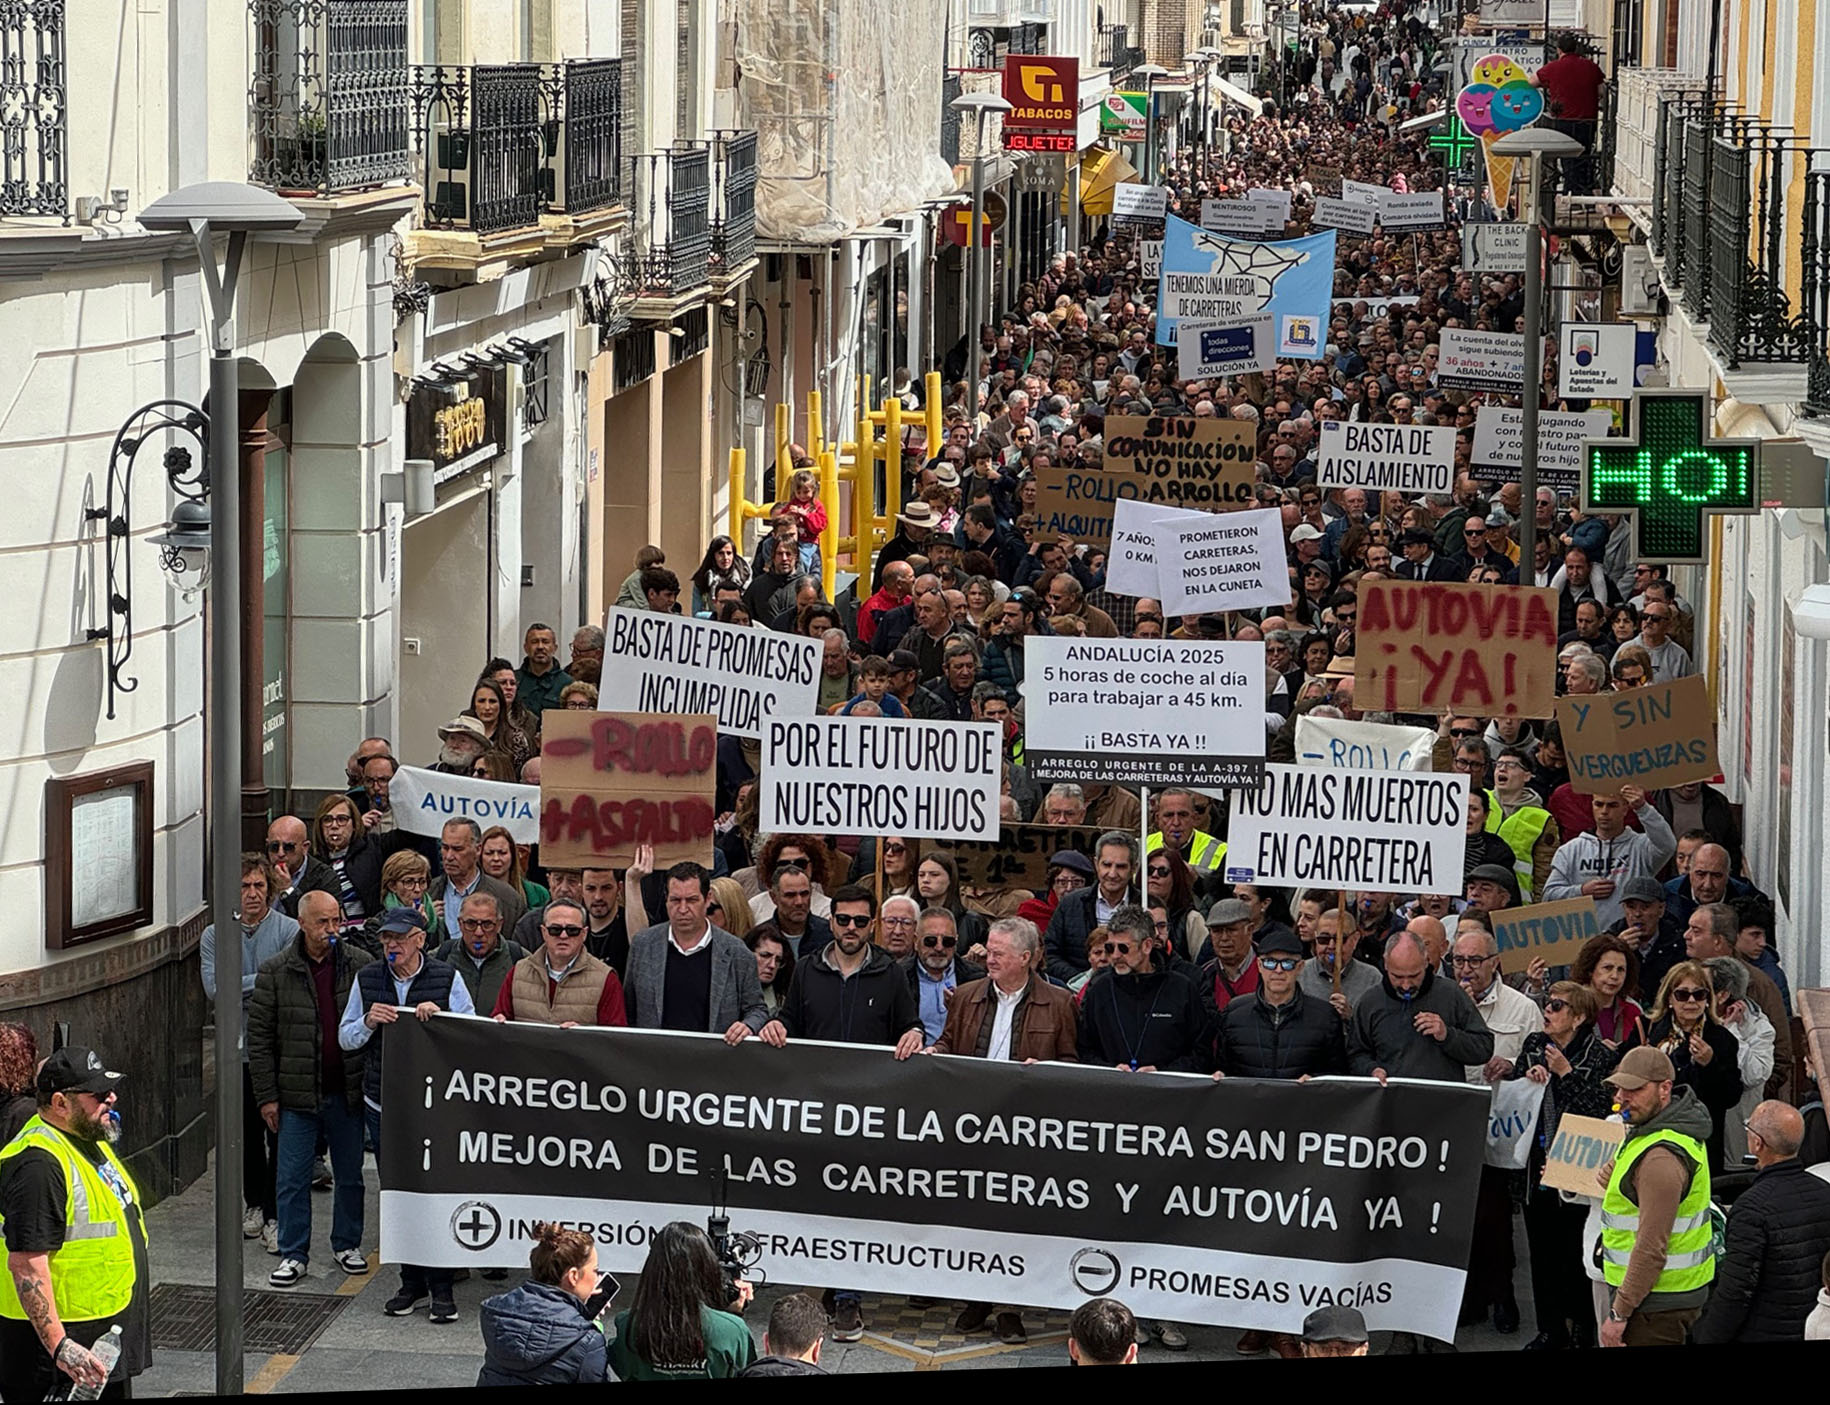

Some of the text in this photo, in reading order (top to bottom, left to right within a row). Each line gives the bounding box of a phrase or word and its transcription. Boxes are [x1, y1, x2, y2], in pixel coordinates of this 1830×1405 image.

[1010, 107, 1073, 120] TABACOS
[1023, 176, 1056, 186] ROMA
[1211, 203, 1256, 212] MENTIROSOS
[1487, 226, 1527, 234] THE BACK
[1494, 238, 1520, 247] CLINIC
[1148, 244, 1160, 258] LA
[1144, 262, 1156, 276] SE
[1166, 274, 1256, 296] TENEMOS UNA MIERDA
[1179, 298, 1242, 318] DE CARRETERAS
[1180, 322, 1216, 331] Carreteras
[1208, 338, 1228, 346] todas
[1450, 334, 1508, 346] La cuenta del
[1208, 344, 1250, 355] direcciones
[1458, 345, 1524, 358] sigue subiendo
[1197, 363, 1246, 376] SOLUCIÓN
[1446, 356, 1510, 370] 36 años 7
[1569, 368, 1607, 378] Loterías y
[1570, 377, 1604, 385] Apuestas
[1540, 416, 1586, 428] jugando
[1495, 428, 1516, 436] con
[1345, 426, 1434, 456] BASTA DE
[1498, 440, 1580, 452] y futuro
[1488, 450, 1580, 466] de hijo
[1134, 458, 1222, 481] NO HAY
[1322, 458, 1448, 490] AISLAMIENTO
[1116, 531, 1124, 542] 7
[1180, 526, 1258, 544] PROMETIERON
[1125, 550, 1153, 564] 0 KM
[1184, 544, 1258, 560] CARRETERAS,
[1182, 562, 1261, 579] NOS DEJARON
[1185, 578, 1263, 596] EN LA CUNETA
[612, 614, 816, 686] BASTA DE PROMESAS
[1066, 644, 1225, 664] ANDALUCÍA 2025
[1044, 666, 1248, 686] 5 horas de coche al día
[1048, 690, 1243, 709] para trabajar a 45 km.
[1572, 689, 1672, 732] Y SIN
[770, 722, 996, 776] POR EL FUTURO DE
[1100, 732, 1162, 748] BASTA
[1166, 734, 1190, 750] YA
[1042, 758, 1248, 774] ARREGLO URGENTE DE LA A-397
[1565, 738, 1708, 780] VERGUENZAS
[1036, 769, 1254, 785] MEJORA DE LAS CARRETERAS Y AUTOVÍA YA
[420, 792, 534, 820] AUTOVÍA
[774, 781, 986, 834] NUESTROS HIJOS
[1238, 771, 1462, 828] NO MAS MUERTOS
[1257, 832, 1434, 886] EN CARRETERA
[1496, 911, 1600, 952] AUTOVIA
[444, 1069, 628, 1114] ARREGLO
[639, 1088, 824, 1134] URGENTE
[834, 1104, 886, 1139] DE
[897, 1108, 944, 1143] LA
[955, 1113, 1194, 1158] CARRETERA
[1204, 1128, 1286, 1162] SAN
[1297, 1132, 1428, 1169] PEDRO
[1438, 1140, 1450, 1172] !
[1550, 1131, 1619, 1169] AUTOV
[458, 1131, 622, 1171] MEJORA
[648, 1144, 700, 1176] DE
[723, 1154, 798, 1187] LAS
[822, 1162, 1090, 1210] CARRETERAS
[1115, 1182, 1140, 1214] Y
[1163, 1185, 1338, 1232] AUTOVÍA
[1364, 1196, 1404, 1231] YA
[1429, 1202, 1442, 1234] !
[508, 1218, 657, 1246] INRSIÓ
[1130, 1266, 1290, 1302] PROMESAS
[1299, 1280, 1394, 1308] VACÍAS
